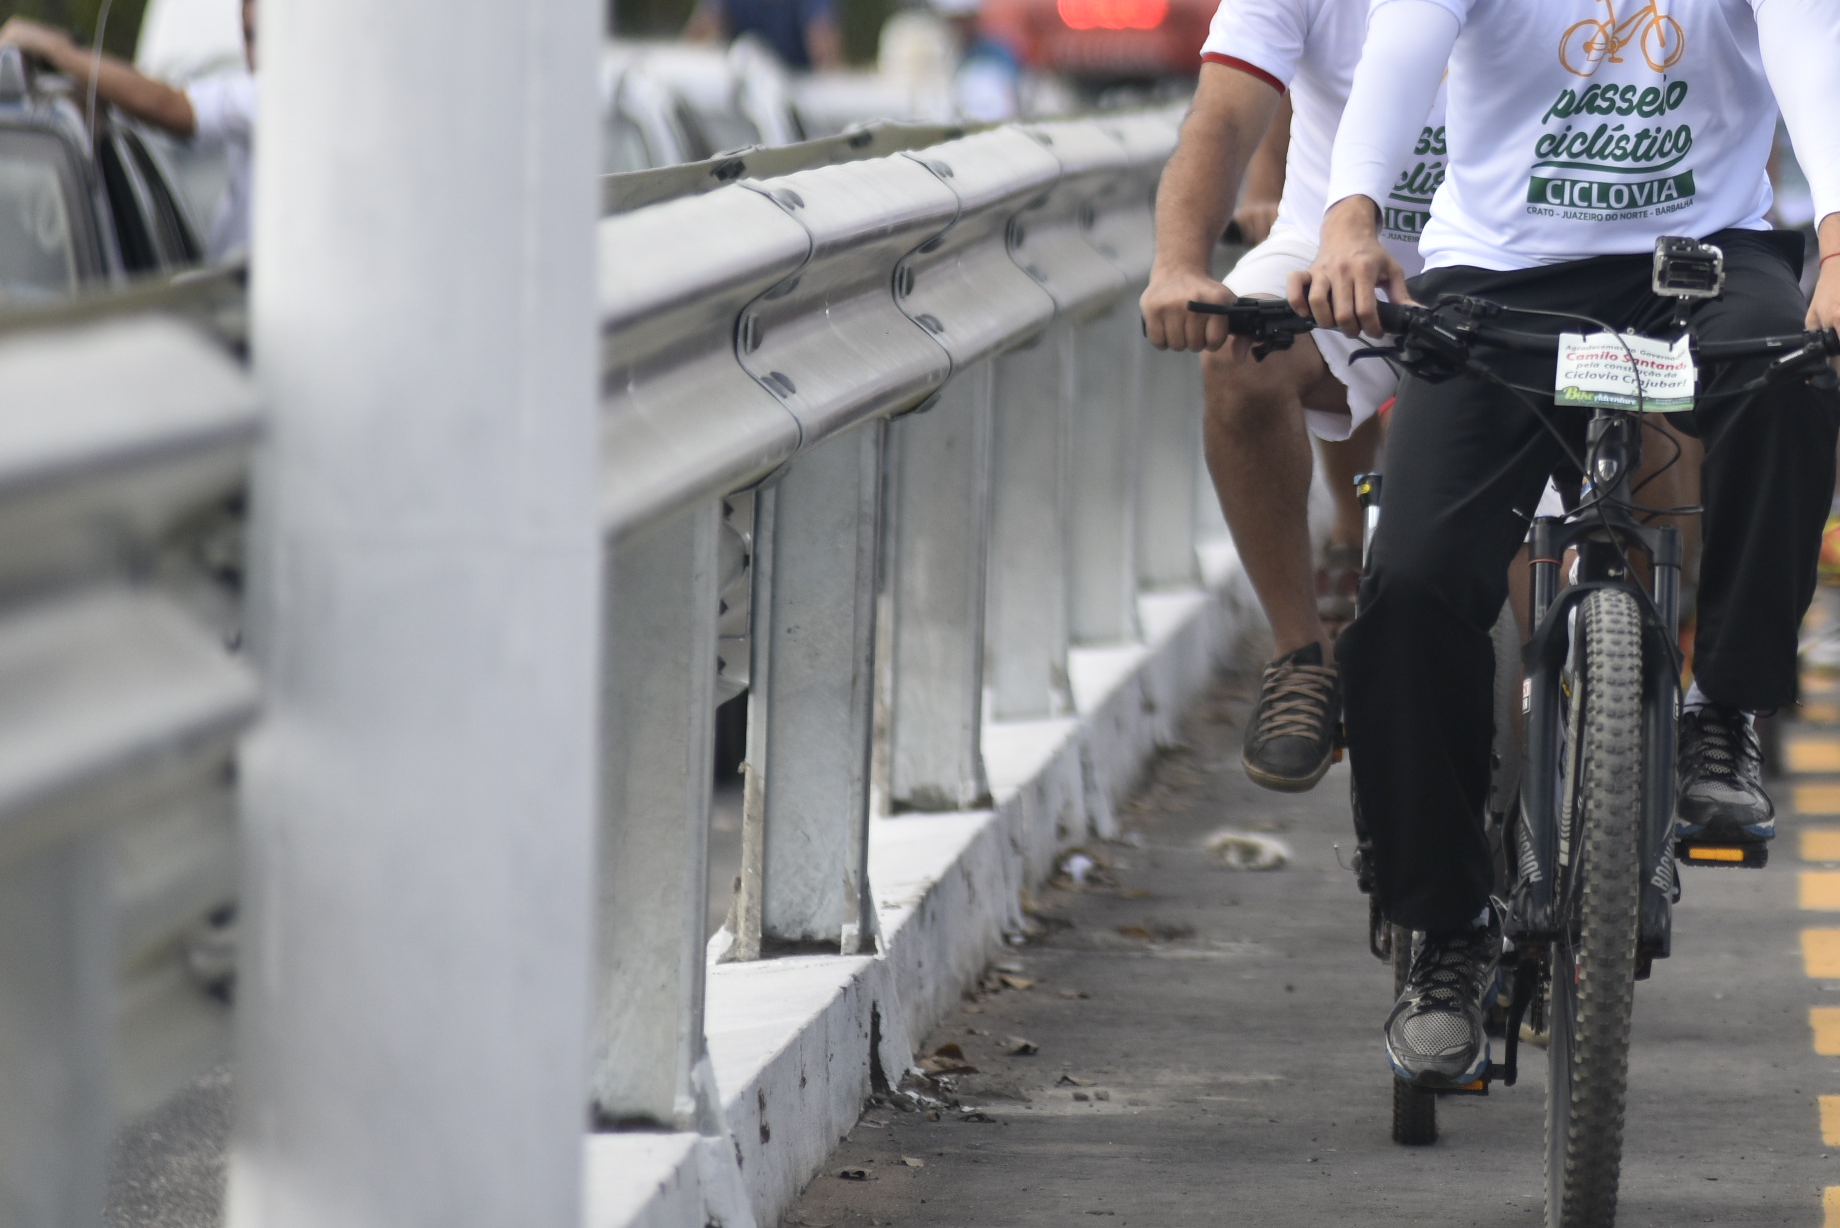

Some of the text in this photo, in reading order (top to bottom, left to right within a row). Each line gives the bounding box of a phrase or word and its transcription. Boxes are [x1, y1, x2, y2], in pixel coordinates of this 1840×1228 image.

[1541, 74, 1688, 124] passeio
[1533, 123, 1692, 165] ciclístico
[1545, 178, 1679, 209] CICLOVIA
[1526, 206, 1554, 217] CRATO
[1561, 211, 1603, 222] JUAZEIRO
[1605, 213, 1618, 221] DO
[1619, 210, 1648, 220] NORTE
[1655, 198, 1694, 216] BARBALHA
[1566, 351, 1619, 362] Camilo
[1576, 362, 1600, 370] pela
[1564, 371, 1619, 381] Ciclovia
